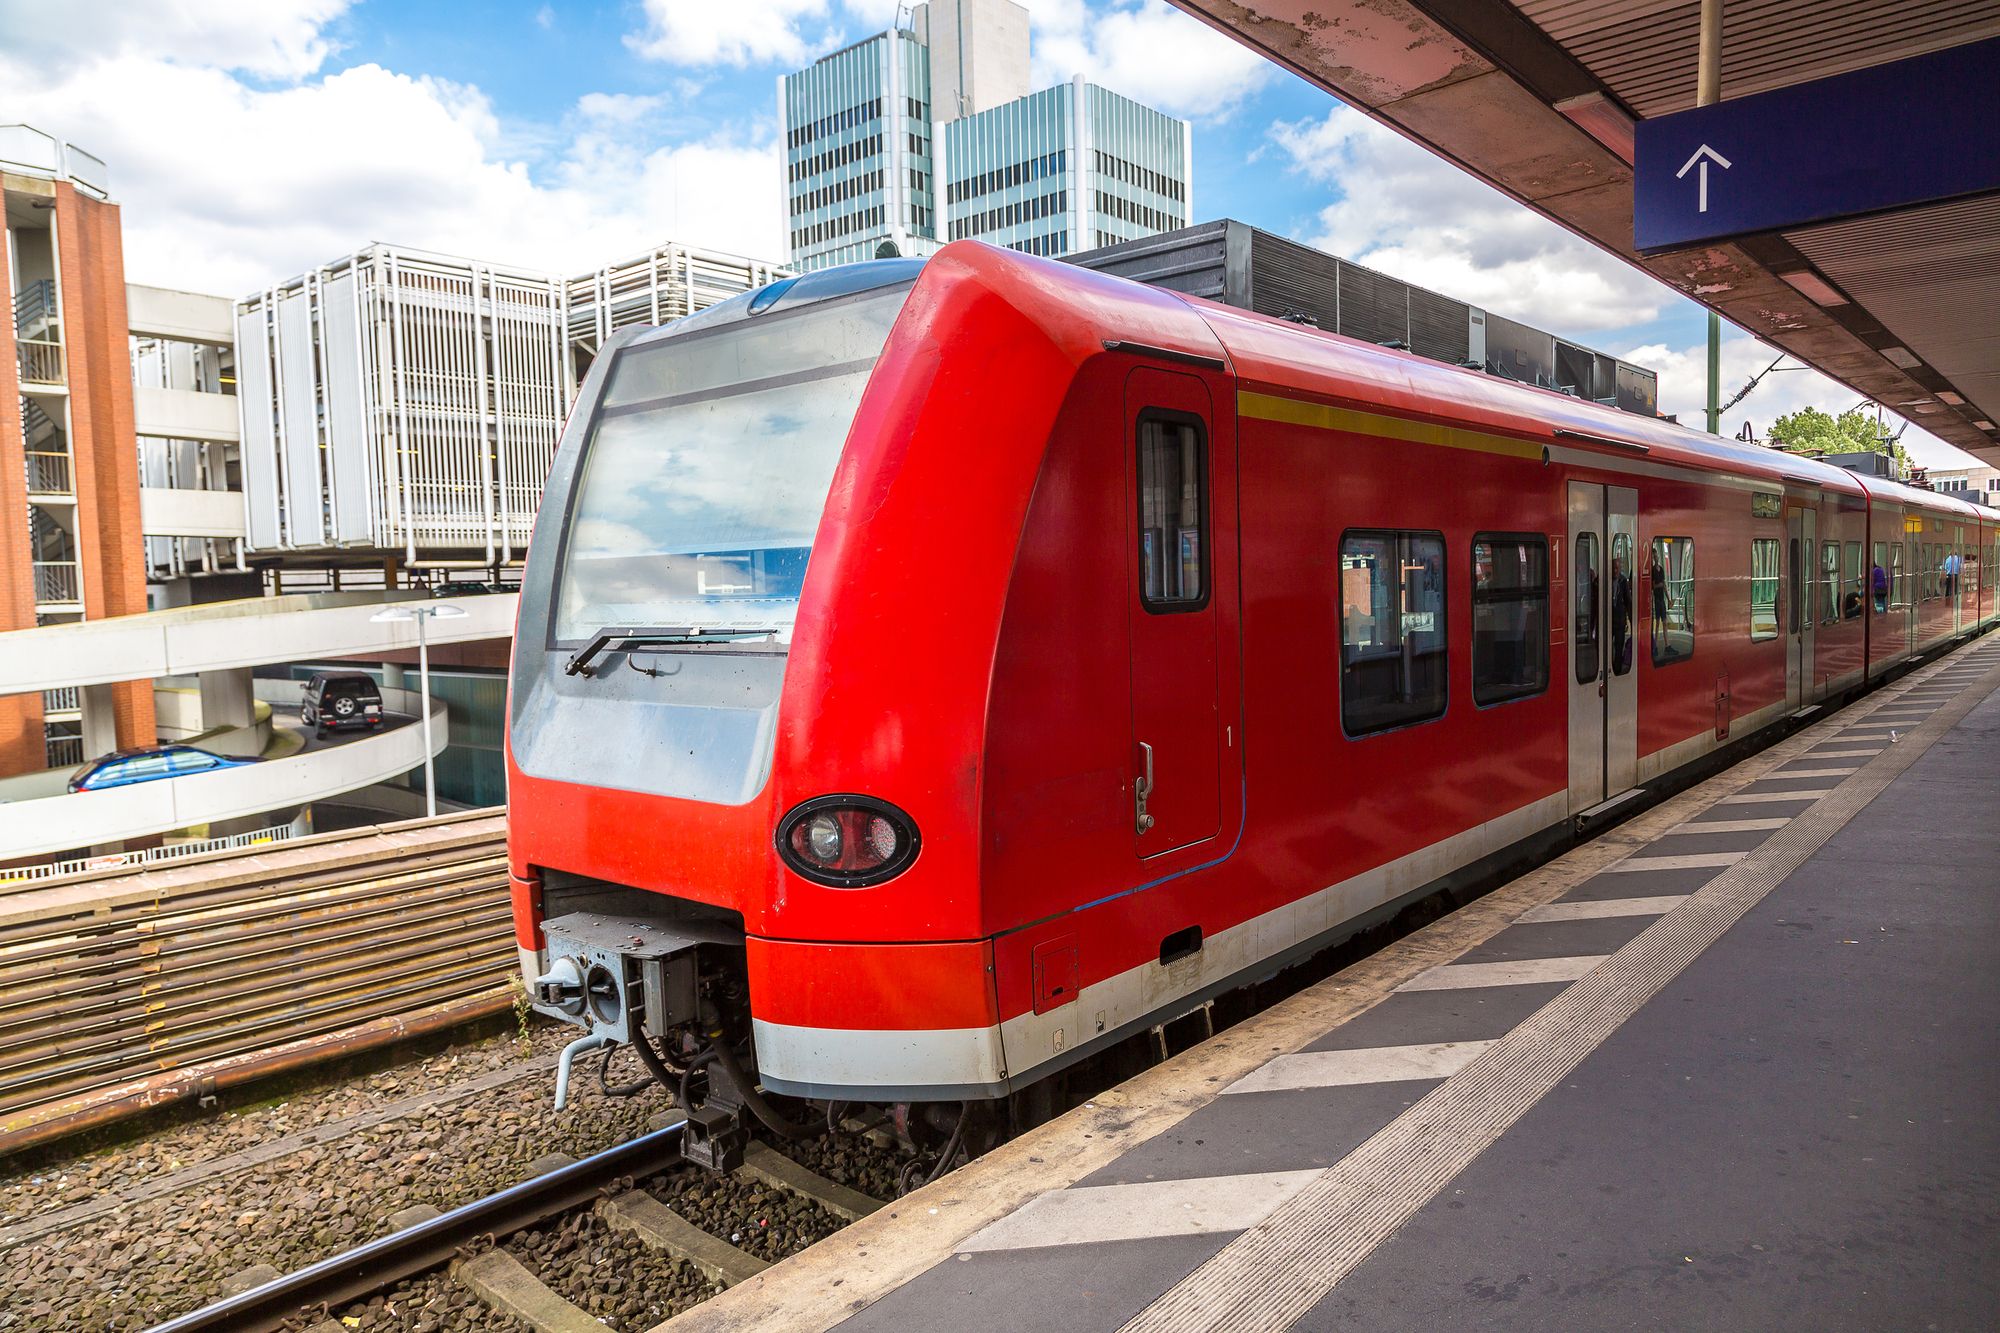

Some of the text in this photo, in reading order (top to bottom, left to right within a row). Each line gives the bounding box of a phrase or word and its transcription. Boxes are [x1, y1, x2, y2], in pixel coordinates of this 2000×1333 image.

[1552, 539, 1559, 578] 1
[1642, 541, 1650, 575] 2
[1226, 725, 1232, 747] 1
